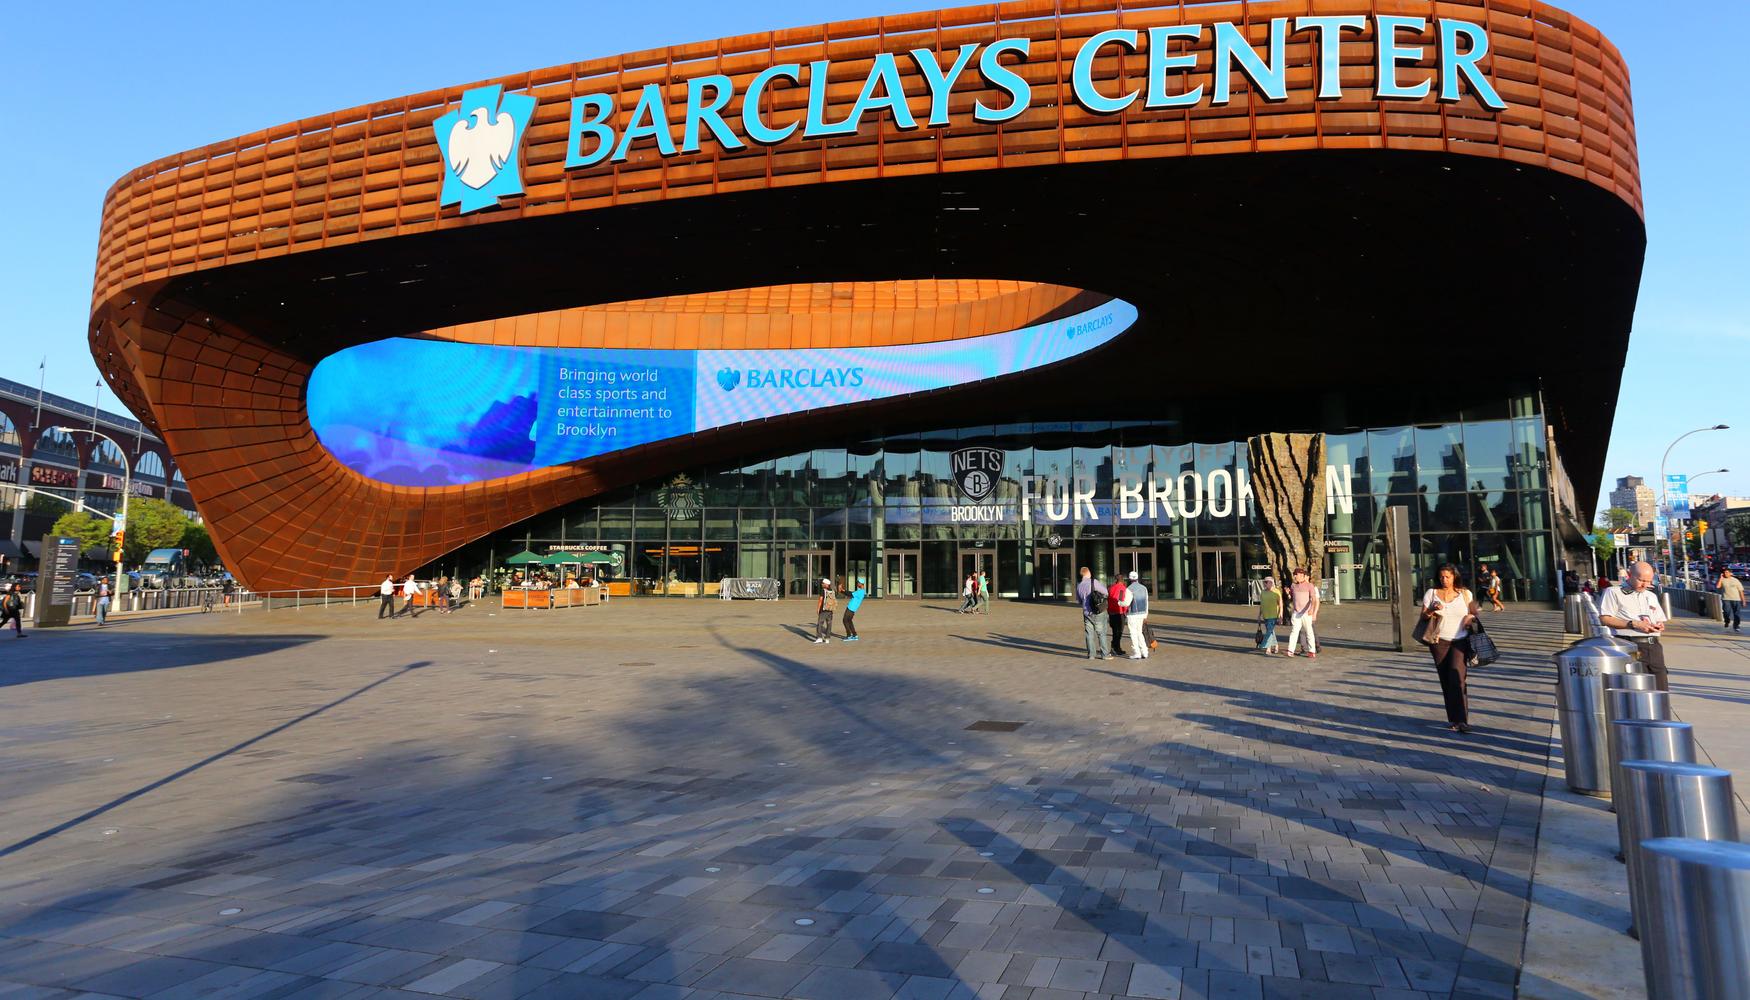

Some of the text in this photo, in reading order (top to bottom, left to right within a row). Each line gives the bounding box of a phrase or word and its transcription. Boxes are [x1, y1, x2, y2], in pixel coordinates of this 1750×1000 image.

[564, 14, 1508, 170] BARCLAYS CENTER
[1076, 313, 1113, 336] BARCLAYS
[559, 367, 658, 384] Bringing world
[746, 367, 864, 389] BARCLAYS
[558, 386, 667, 402] class sports and
[557, 405, 672, 419] entertainment to
[557, 423, 617, 440] Brooklyn
[0, 461, 17, 482] ark
[954, 449, 1001, 474] NETS
[973, 474, 982, 494] B
[1022, 464, 1353, 521] FOR BROOKN
[951, 505, 1004, 522] BROOKLYN
